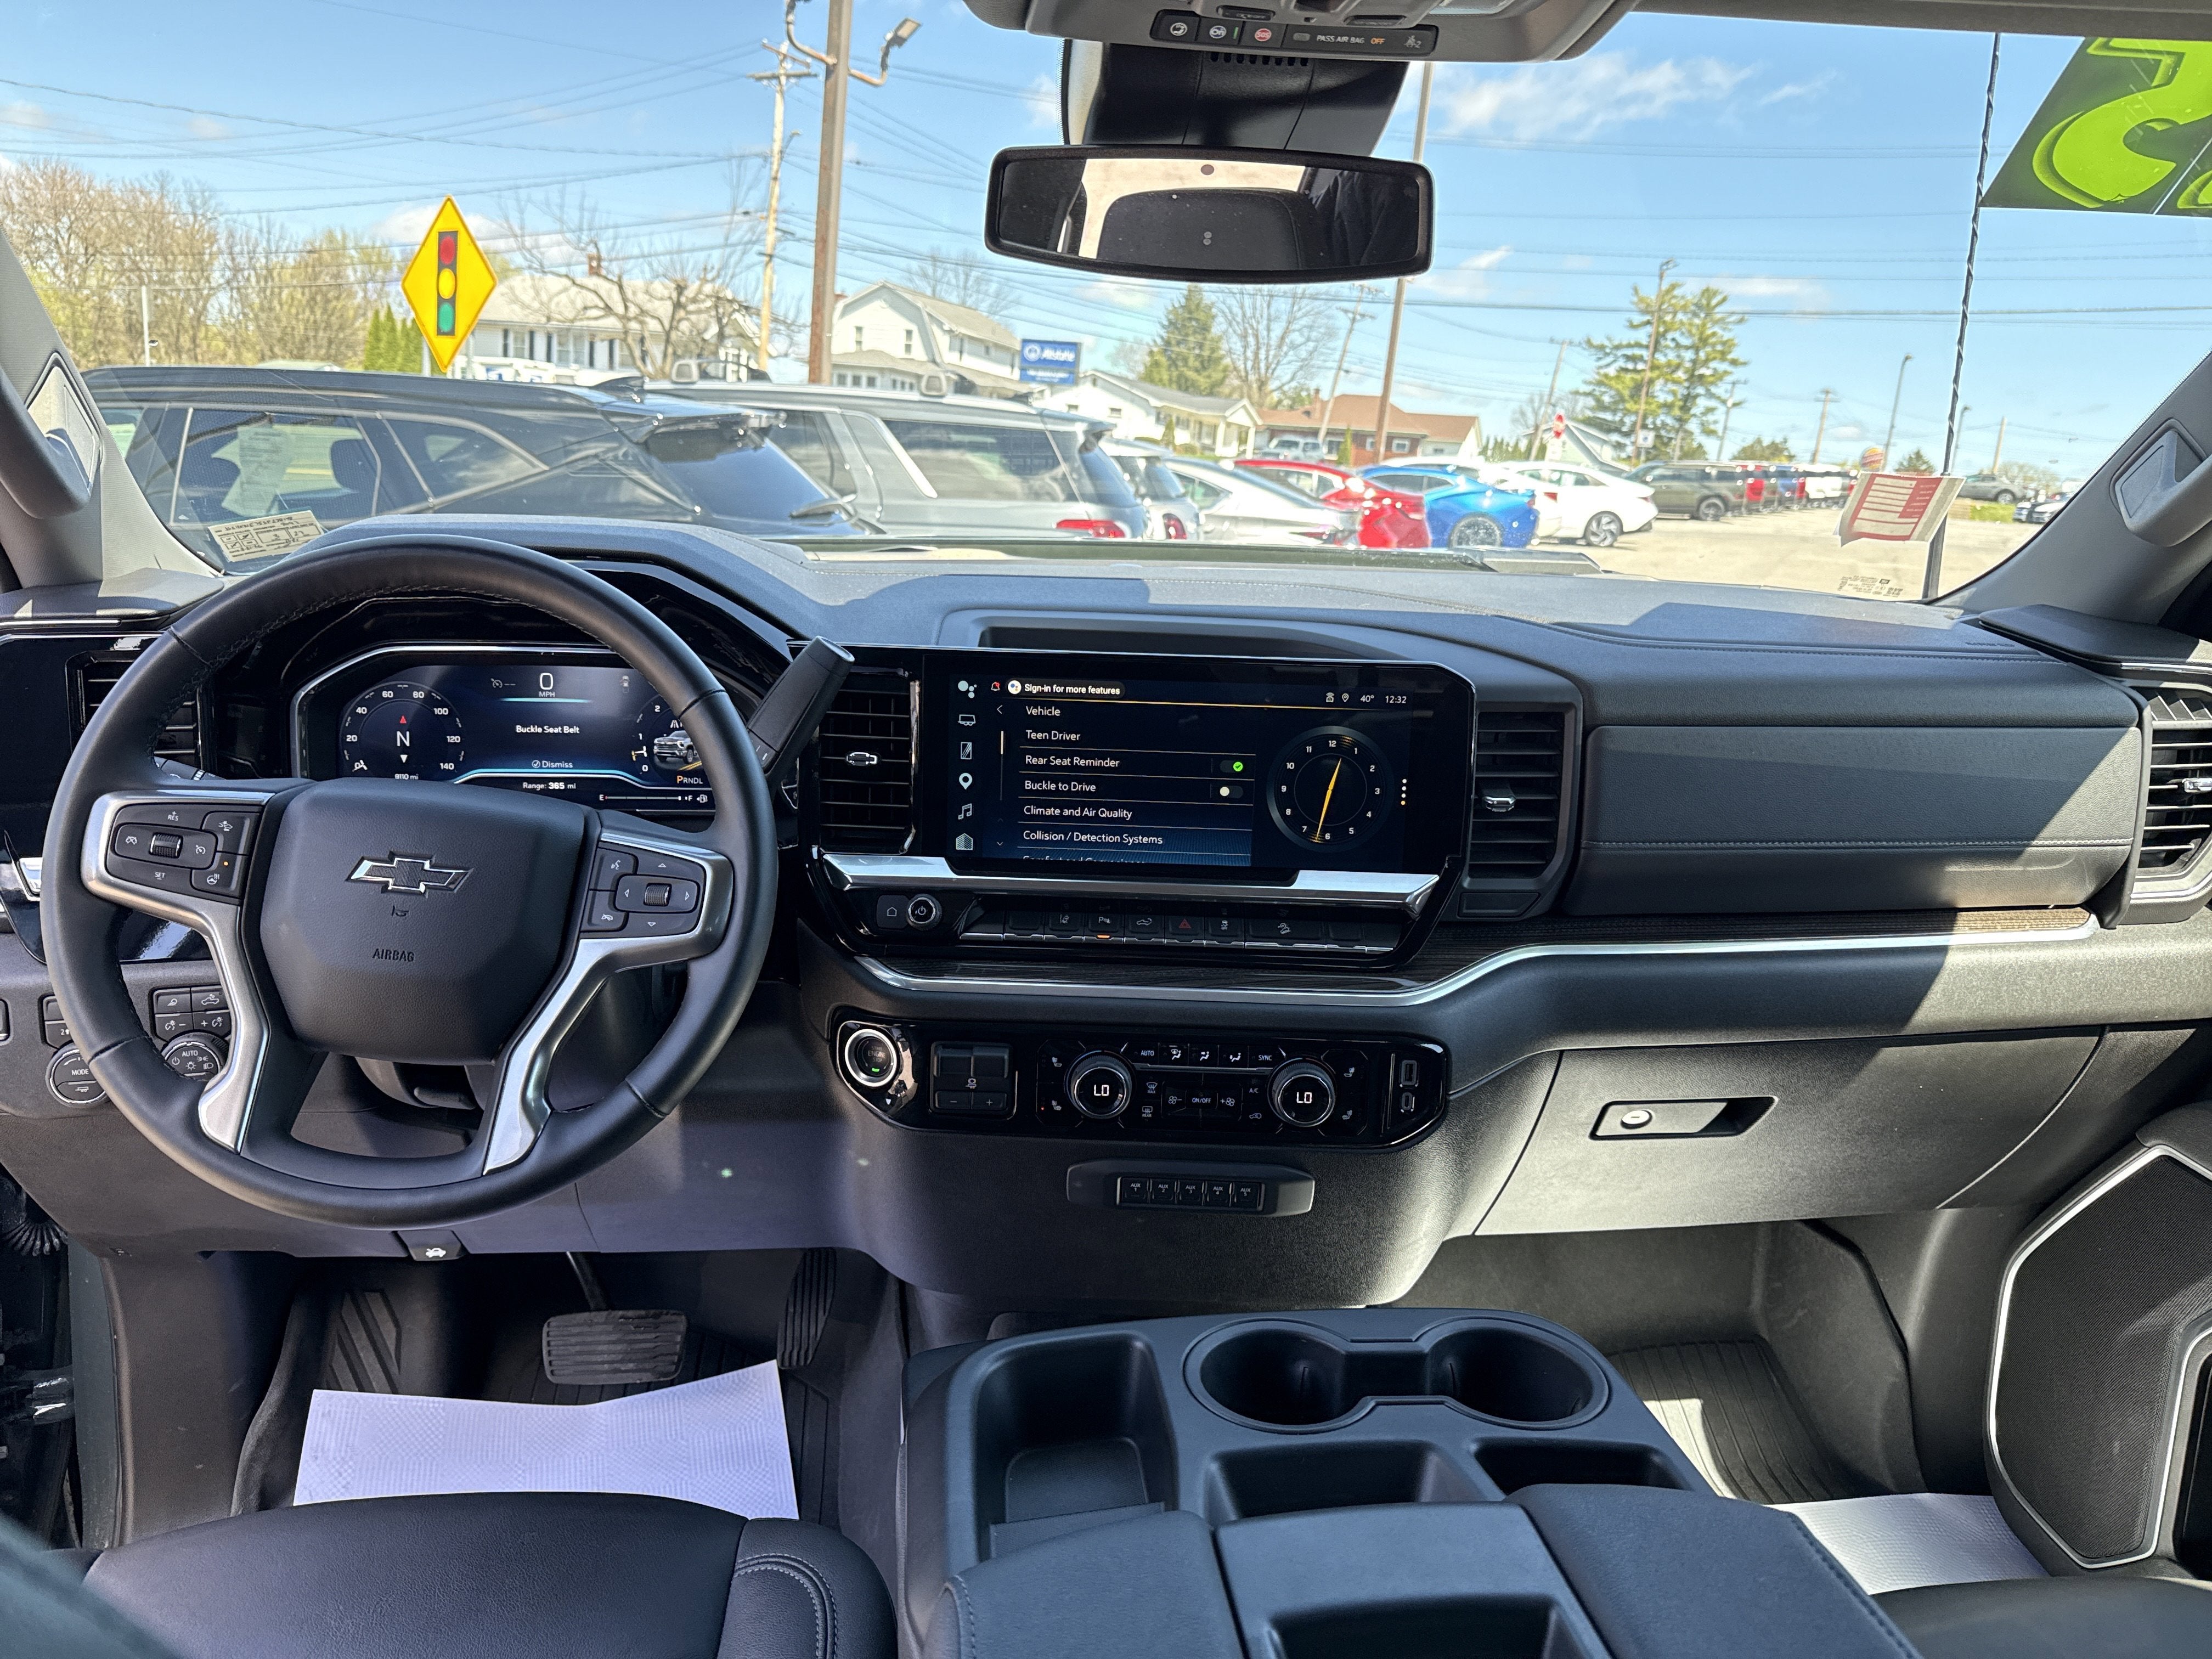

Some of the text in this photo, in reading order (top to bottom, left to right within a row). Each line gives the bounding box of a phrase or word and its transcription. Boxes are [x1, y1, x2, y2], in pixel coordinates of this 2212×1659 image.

[539, 673, 554, 690] 0
[1024, 684, 1051, 693] Sign-in
[1088, 686, 1120, 695] features
[1025, 706, 1060, 716] Vehicle
[516, 725, 542, 734] Buckle
[1025, 730, 1081, 741] Teen Driver
[397, 731, 410, 747] N
[1025, 755, 1120, 767] Rear Seat Reminder
[676, 775, 703, 784] PRNDL
[523, 782, 547, 791] Range:
[1025, 780, 1096, 792] Buckle to Drive
[1024, 805, 1132, 821] Climate and Air Quality
[1023, 830, 1163, 845] Collision / Detection Systems
[372, 949, 414, 962] AIRBAG
[868, 1050, 886, 1058] ENGINE
[1094, 1084, 1109, 1097] LO
[1296, 1092, 1312, 1104] LO
